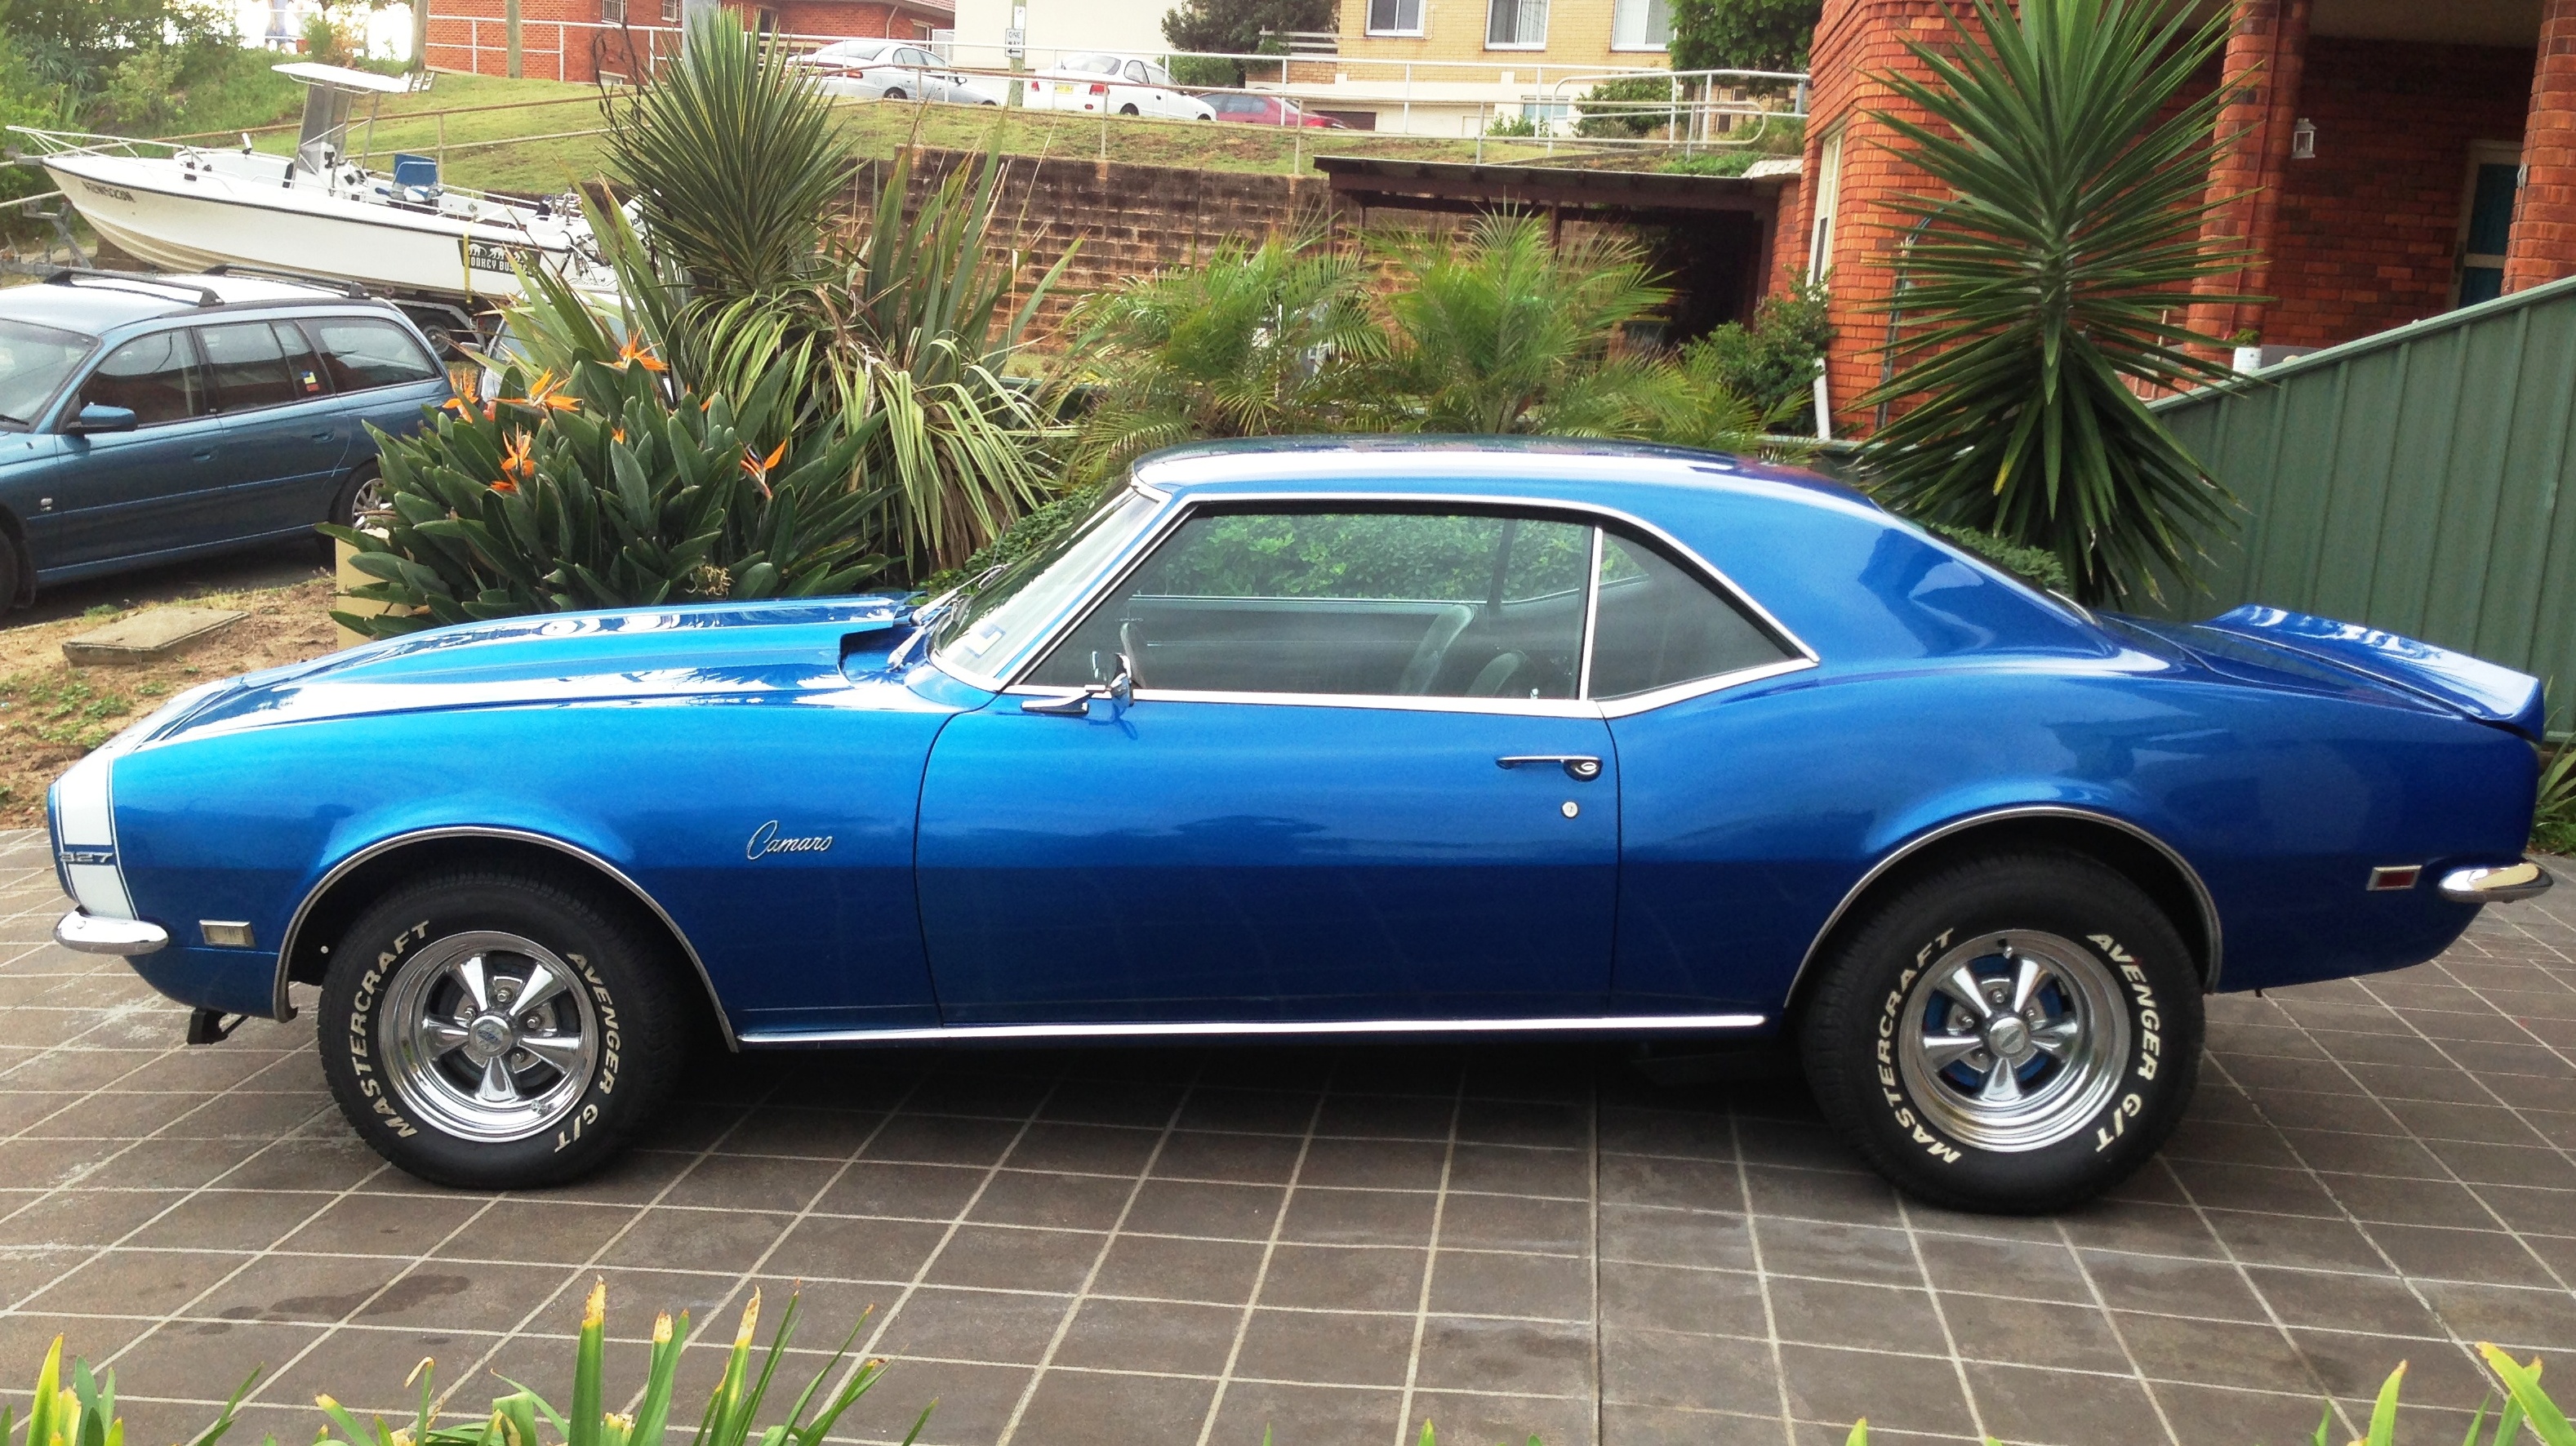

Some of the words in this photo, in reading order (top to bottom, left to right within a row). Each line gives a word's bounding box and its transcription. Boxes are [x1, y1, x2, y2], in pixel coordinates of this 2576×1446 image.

[466, 256, 496, 269] ONKEY
[60, 852, 114, 863] 327
[746, 820, 833, 860] Camaro
[349, 920, 429, 1139] MASTERCRAFT
[567, 952, 622, 1095] AVENGER
[2085, 933, 2161, 1081] AVENGER
[1877, 928, 1961, 1165] MASTERCRAFT
[554, 1104, 599, 1154] G/T
[2095, 1093, 2143, 1153] G/T
